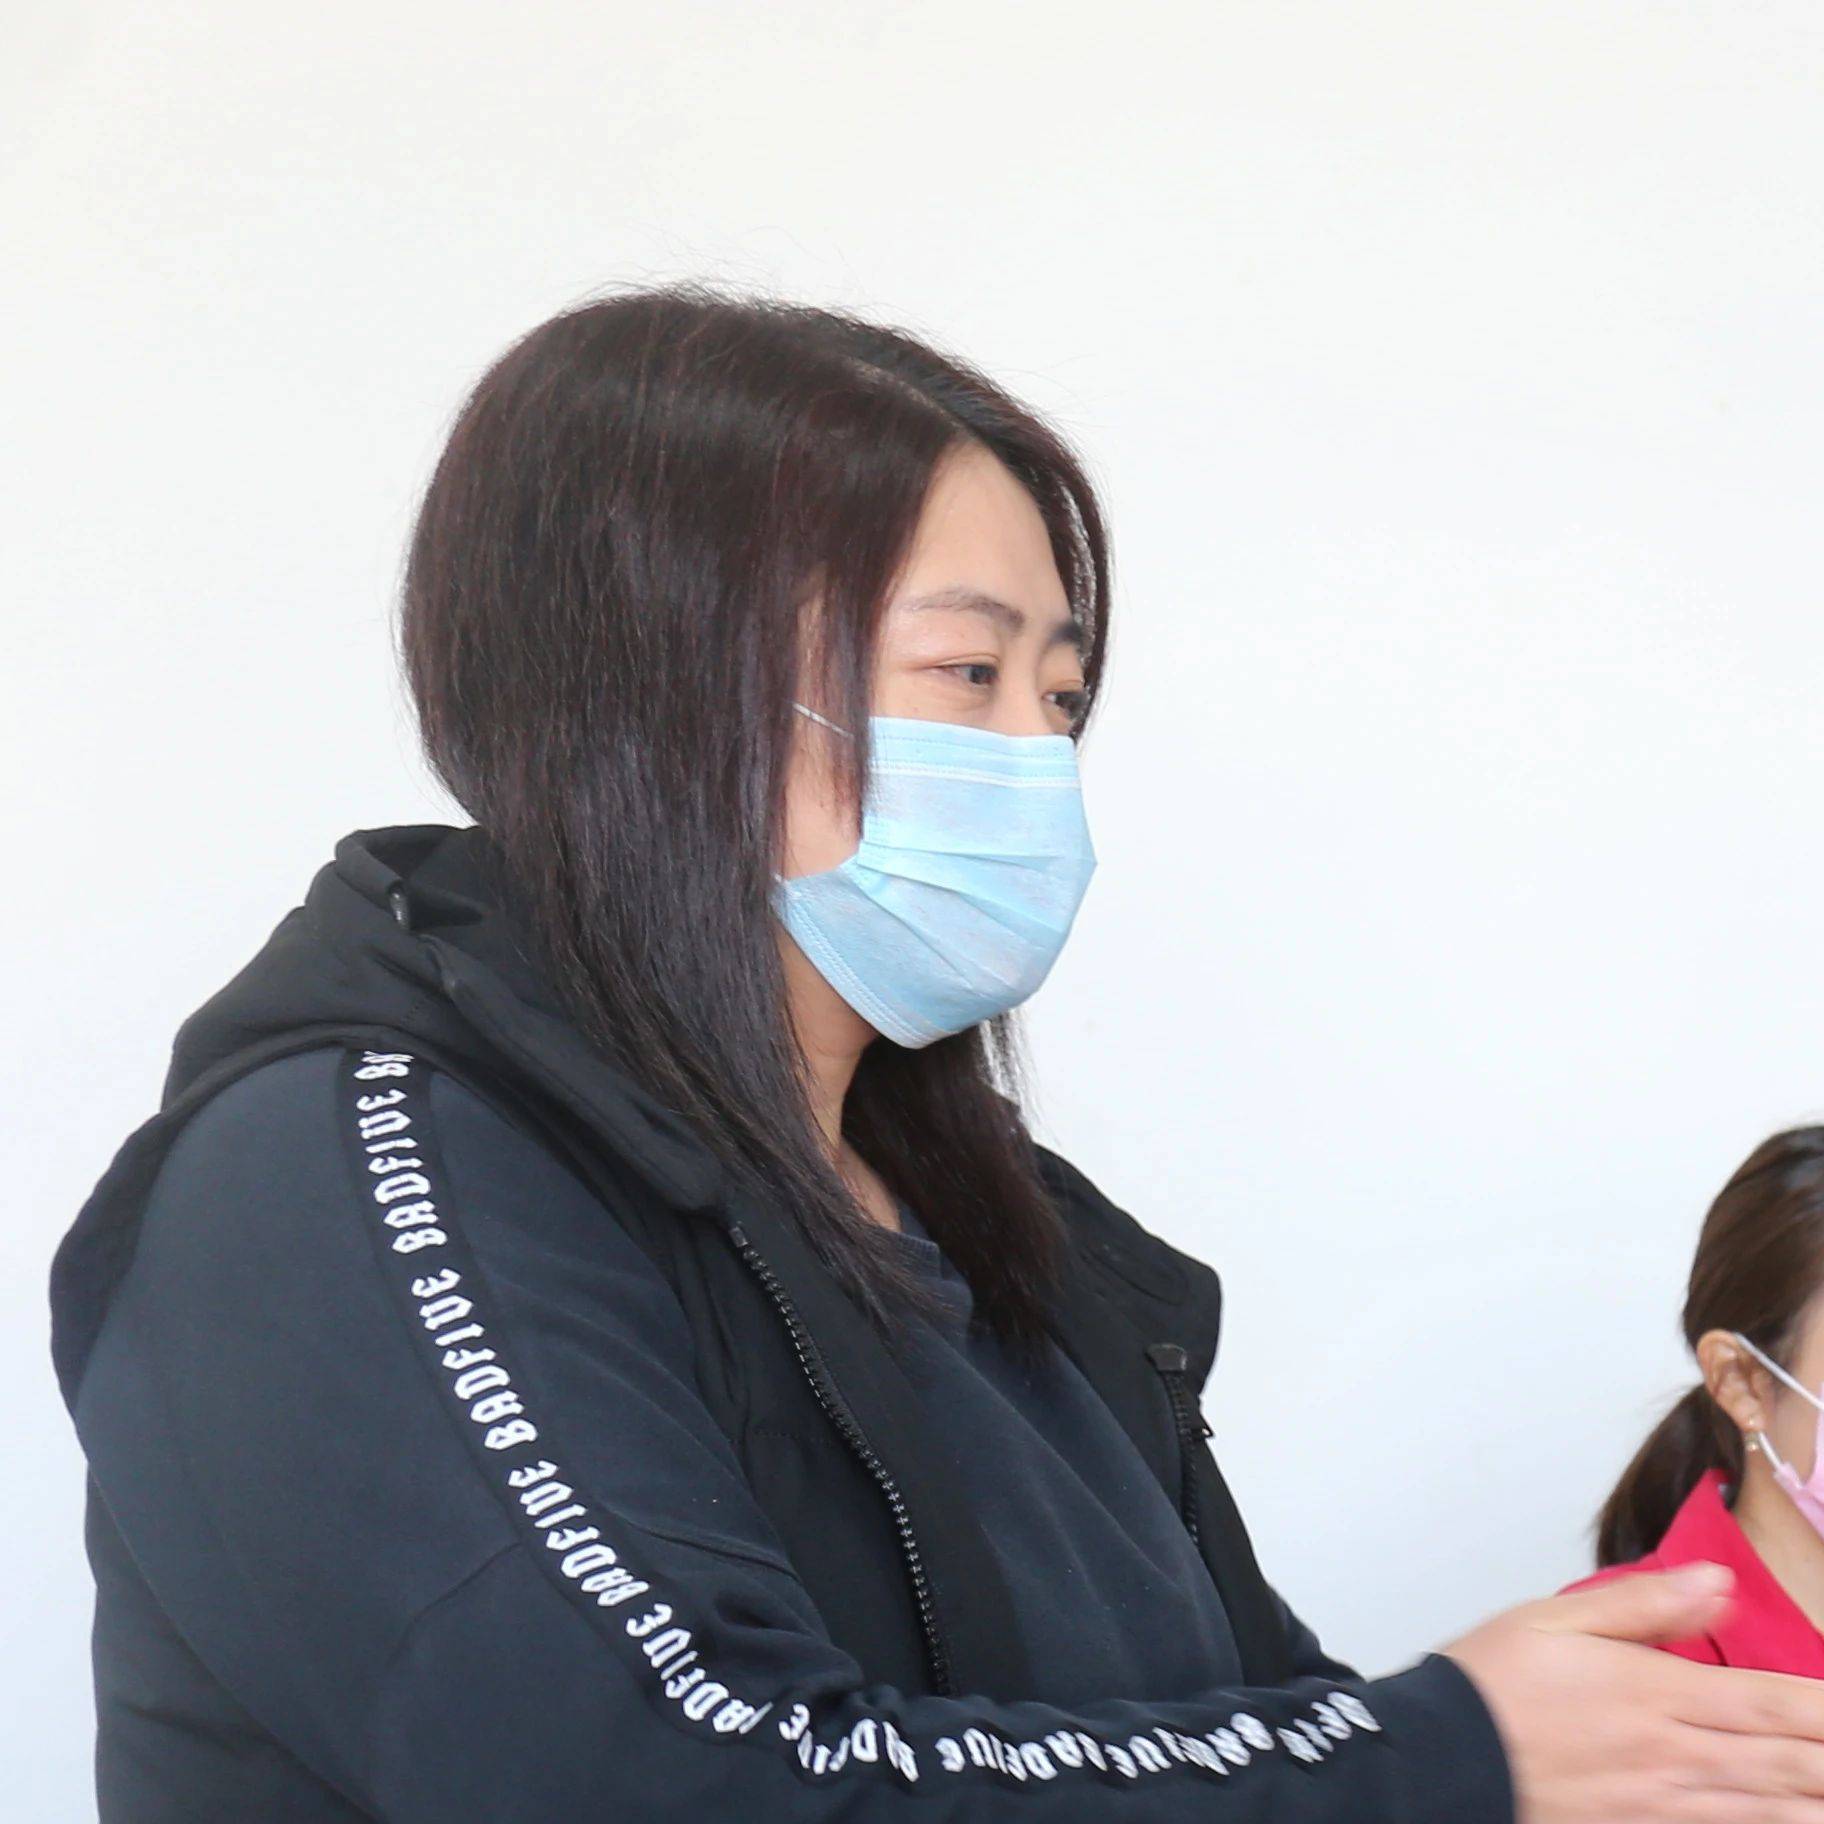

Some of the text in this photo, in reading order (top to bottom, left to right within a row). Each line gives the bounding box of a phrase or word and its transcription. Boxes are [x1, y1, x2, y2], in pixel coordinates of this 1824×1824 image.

[355, 1088, 448, 1255] BADFIVE
[410, 1267, 539, 1451] BADFIVE
[508, 1459, 650, 1607] BADFIVE
